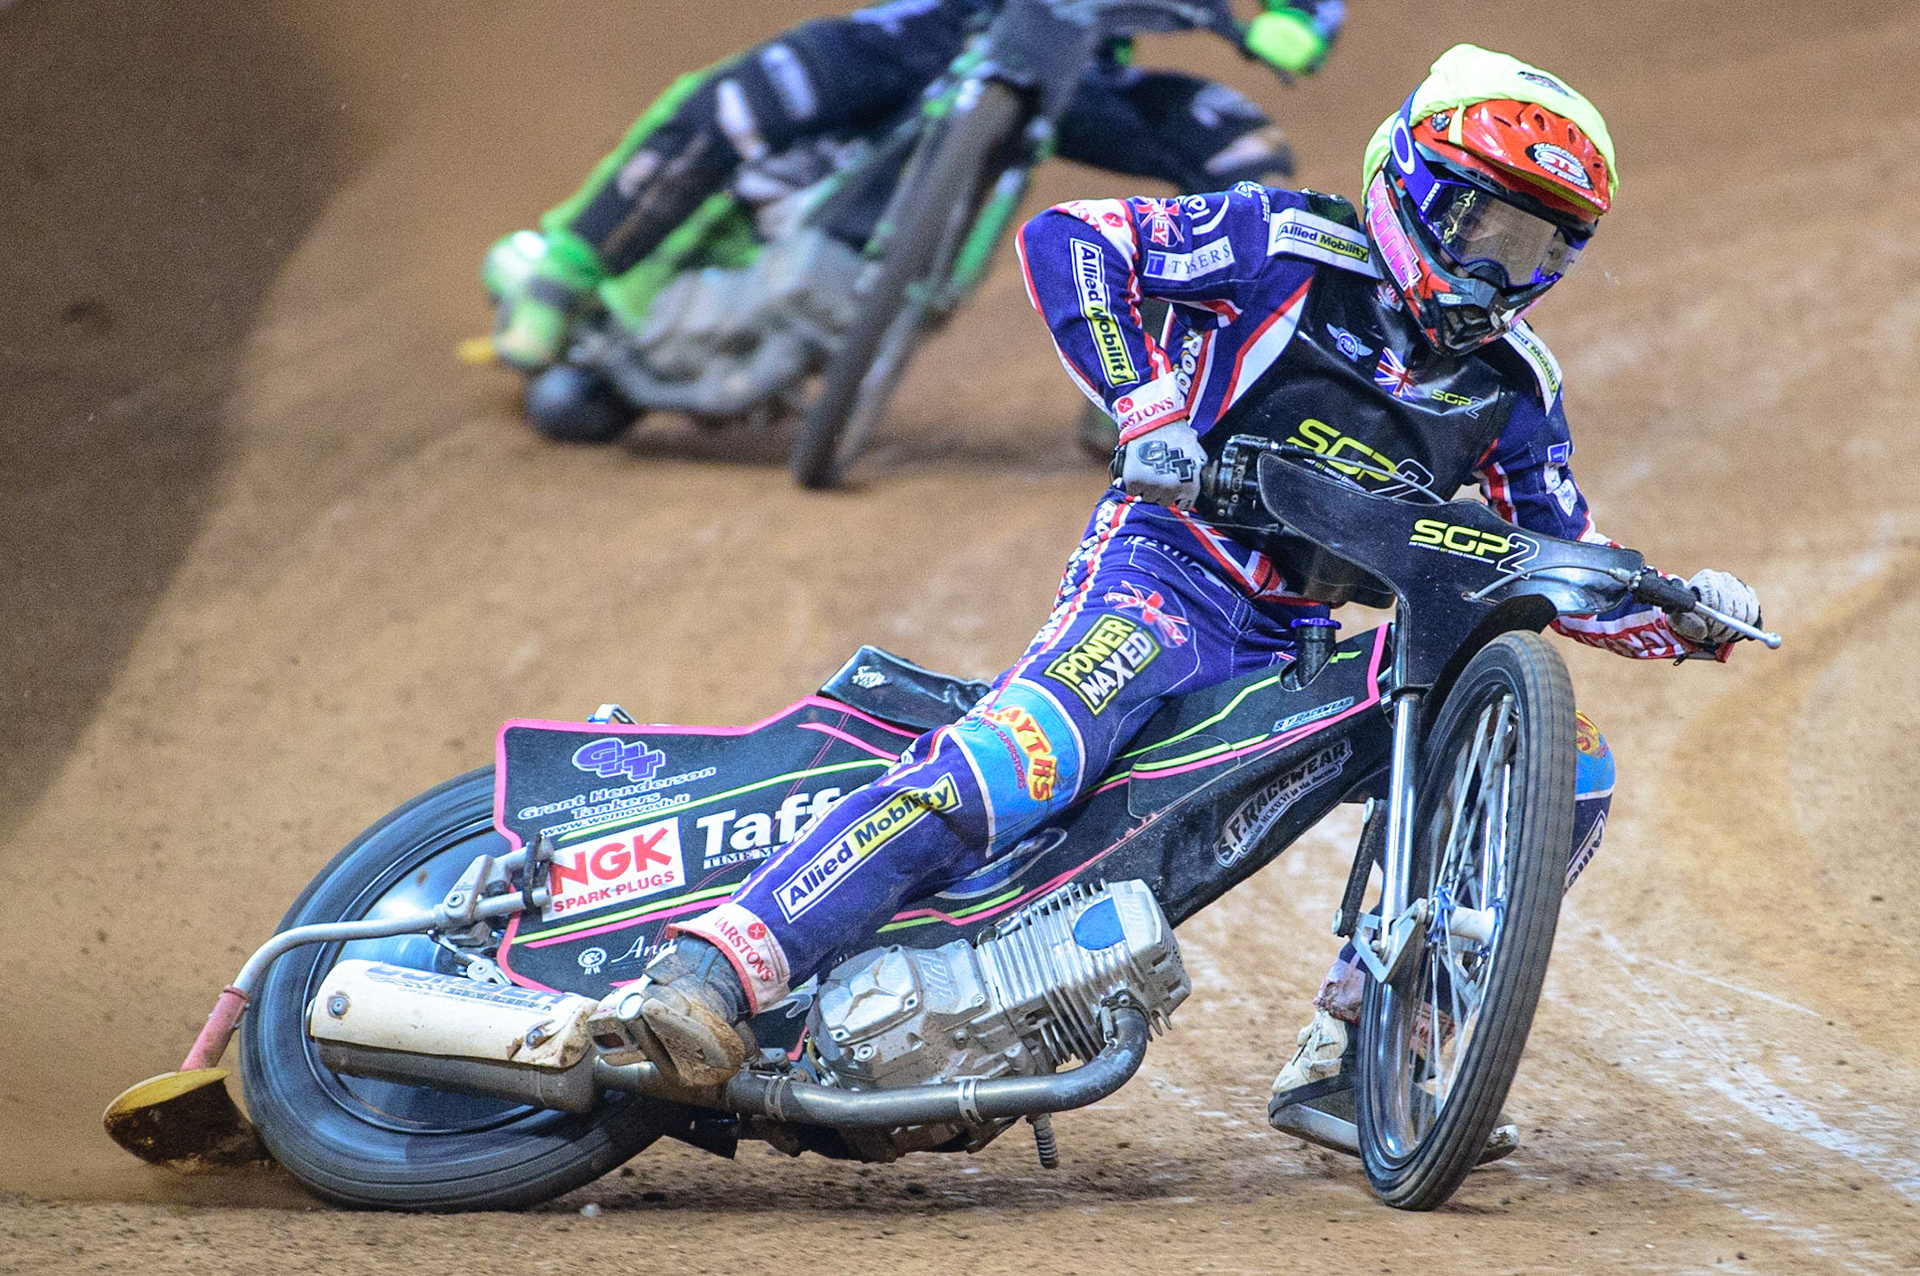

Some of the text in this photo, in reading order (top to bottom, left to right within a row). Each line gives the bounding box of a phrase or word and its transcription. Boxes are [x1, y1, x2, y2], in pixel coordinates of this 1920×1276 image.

[1280, 224, 1370, 259] Allied Mobility
[1081, 245, 1103, 301] Allied
[1090, 306, 1130, 381] Mobility
[1431, 388, 1485, 419] SGP2
[1410, 519, 1540, 580] SGP2
[1058, 619, 1135, 684] POWER
[1078, 631, 1151, 706] MAXED
[518, 767, 716, 820] Grant Henderson
[571, 793, 661, 819] Tankers
[550, 827, 673, 896] NGK
[705, 849, 753, 868] TIME
[788, 785, 949, 906] Allied Mobility
[553, 871, 676, 913] SPARK PLUGS
